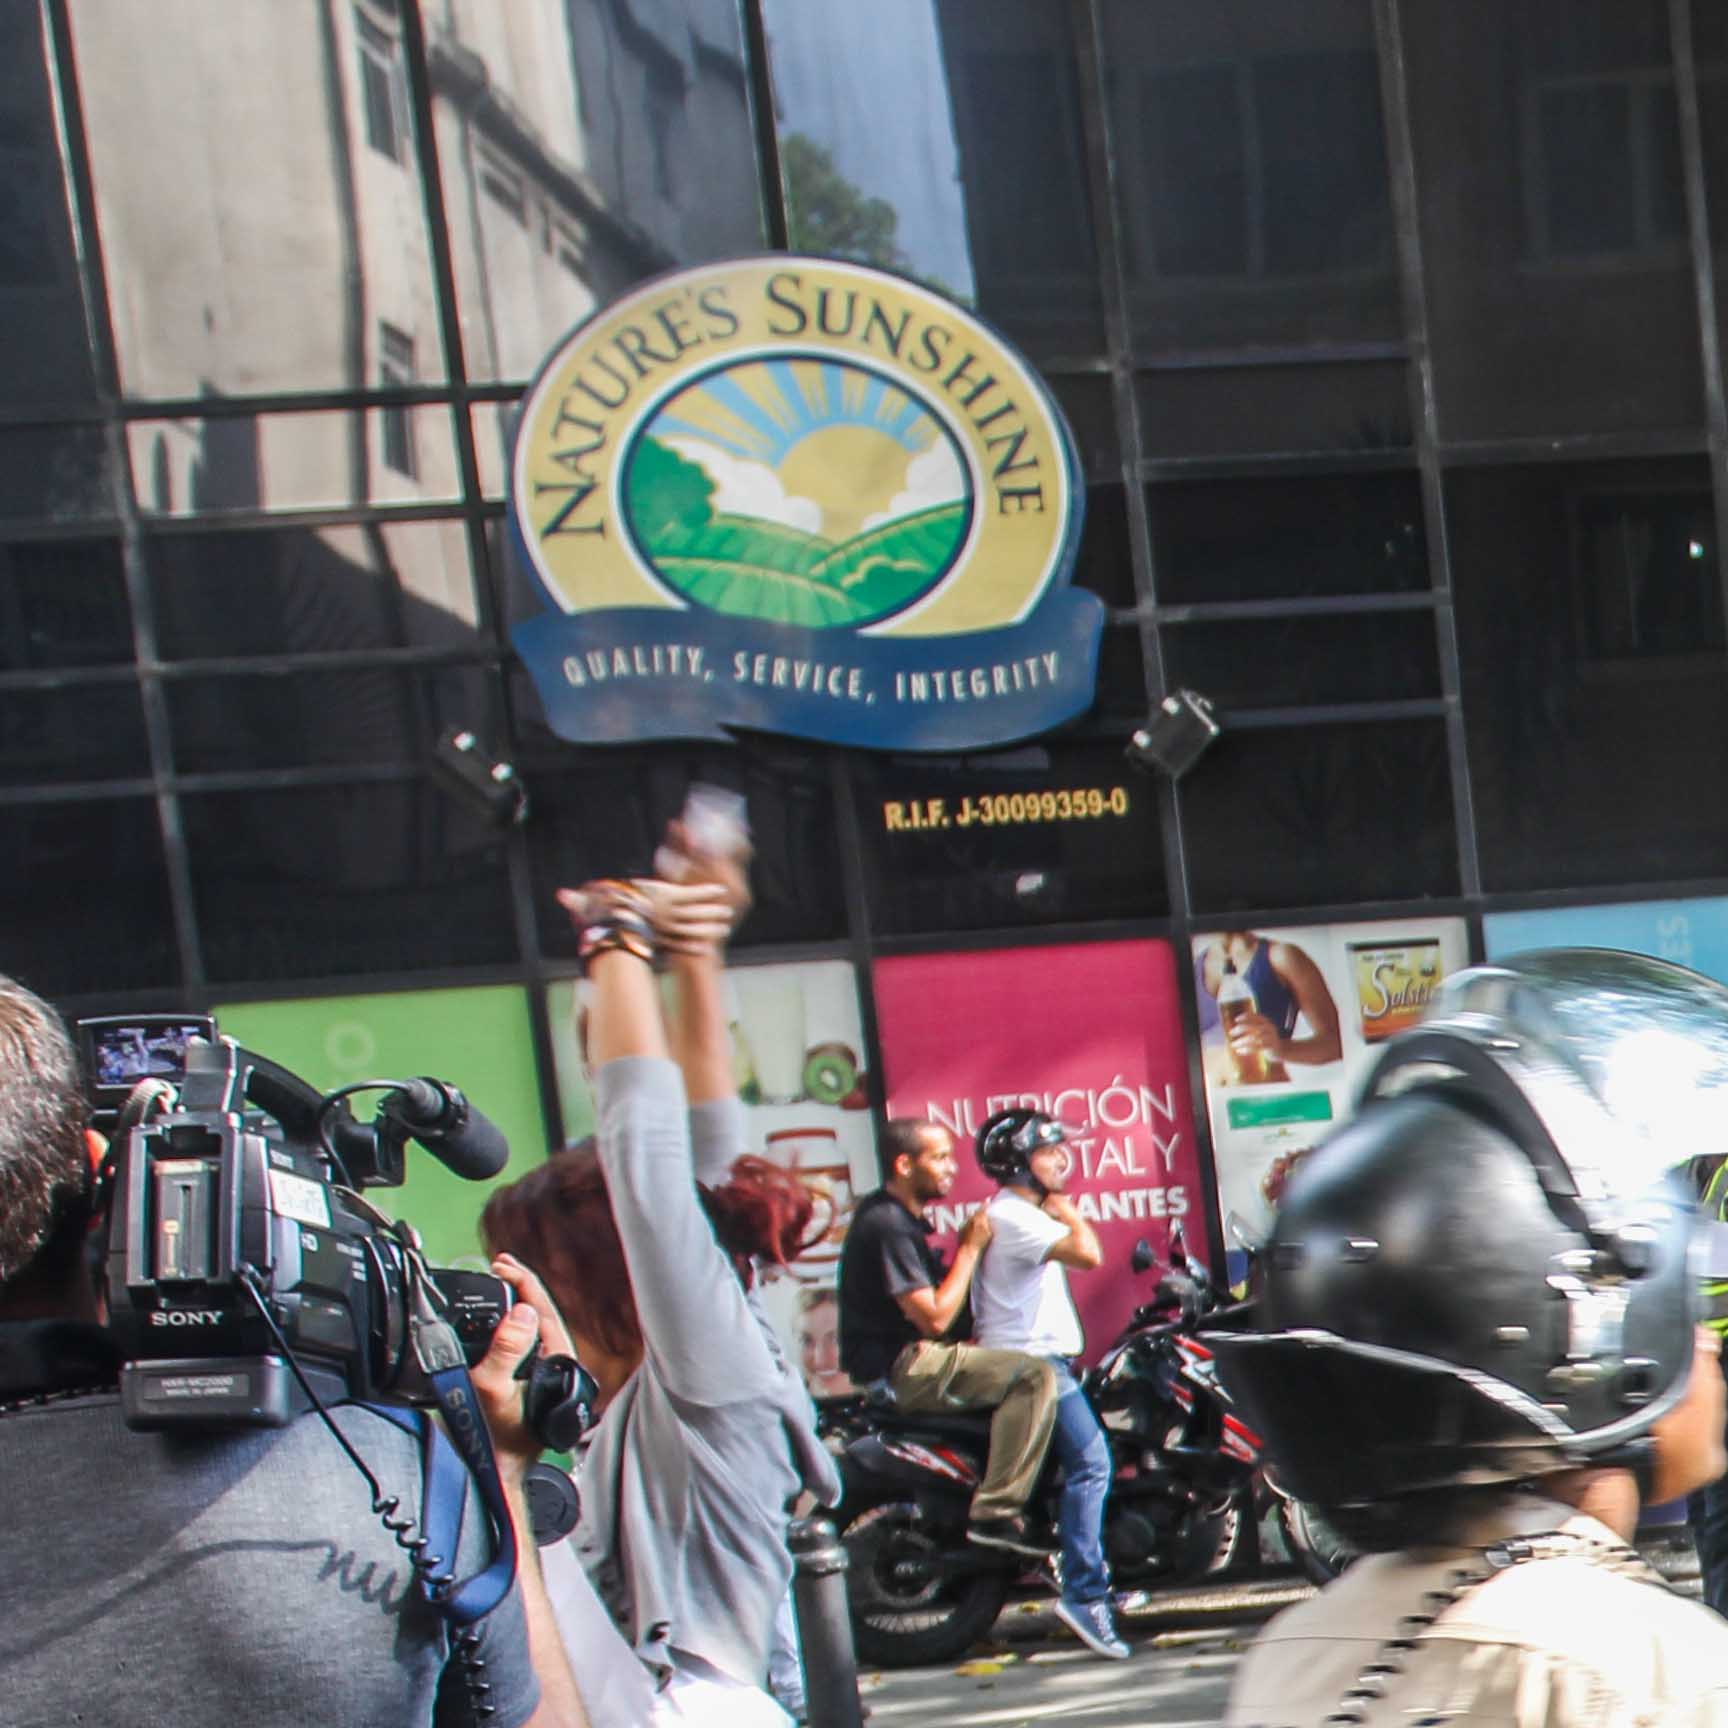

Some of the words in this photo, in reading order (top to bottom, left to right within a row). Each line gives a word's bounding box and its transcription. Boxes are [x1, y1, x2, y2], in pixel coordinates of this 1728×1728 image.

[534, 284, 740, 540] NATURE'S
[765, 273, 1045, 517] SUNSHINE
[562, 644, 715, 688] QUALITY,
[732, 650, 876, 704] SERVICE,
[895, 652, 1060, 702] INTEGRITY
[883, 799, 950, 831] R.I.F.
[955, 786, 1129, 826] J-30099359-0
[1151, 1132, 1181, 1174] Y
[151, 1310, 224, 1327] SONY
